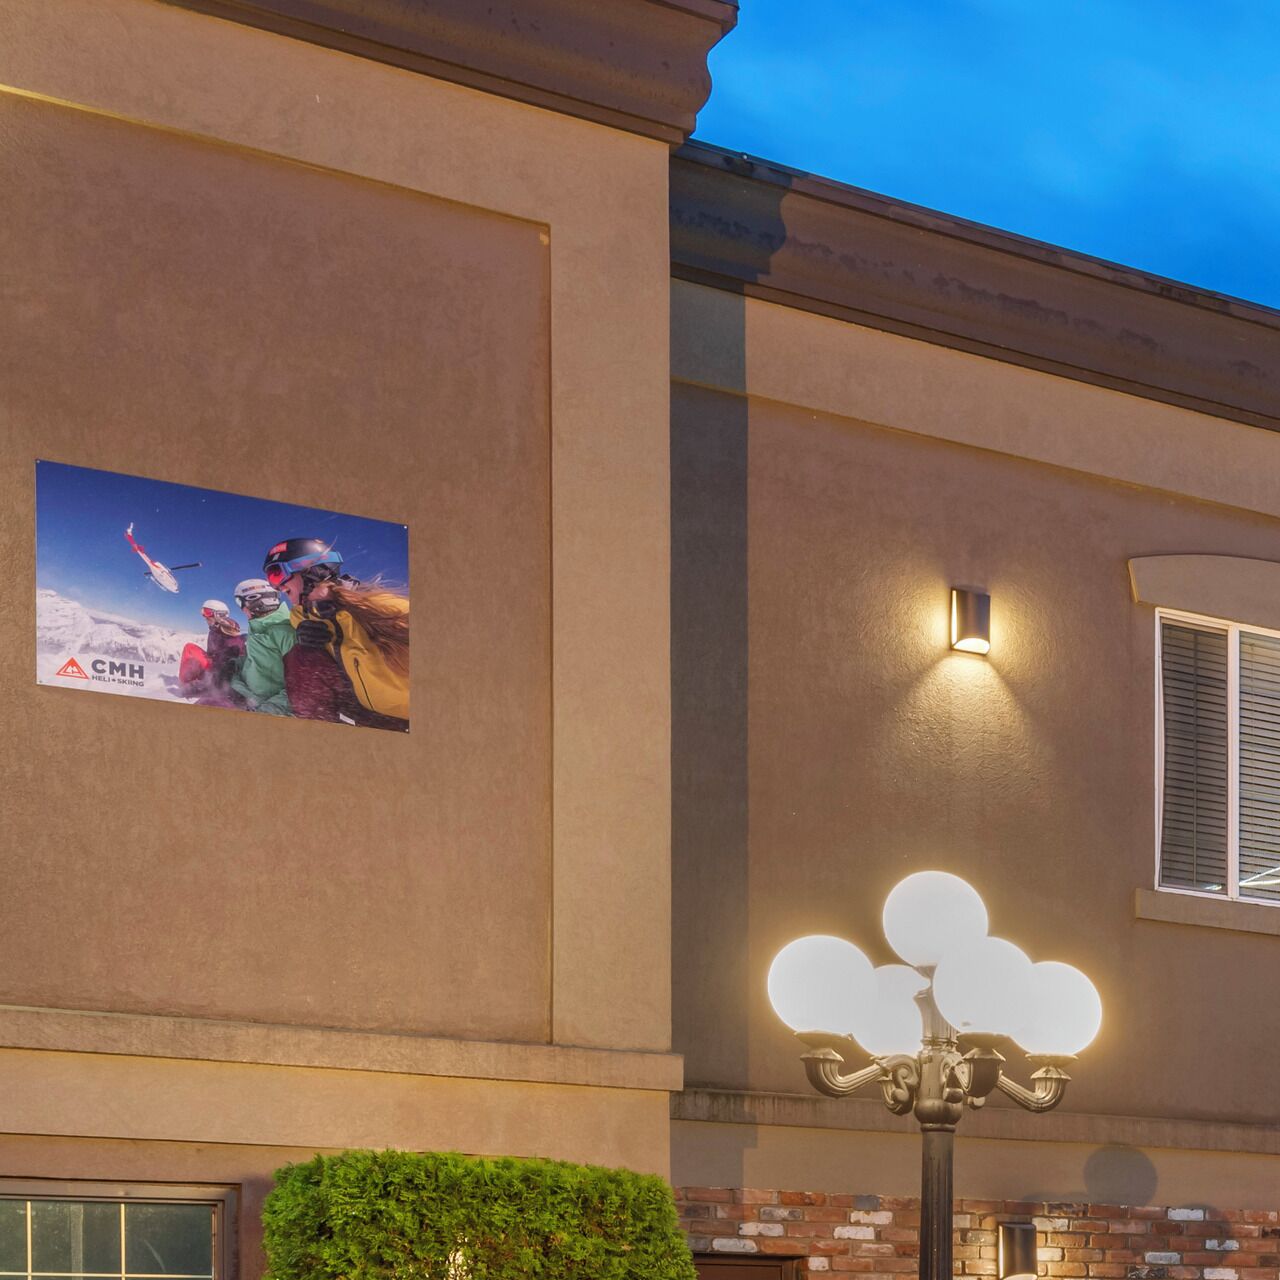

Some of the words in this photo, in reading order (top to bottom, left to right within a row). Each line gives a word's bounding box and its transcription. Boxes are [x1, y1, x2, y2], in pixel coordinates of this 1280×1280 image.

[91, 659, 144, 680] CMH
[92, 675, 111, 683] HELI
[117, 678, 145, 687] SKIING
